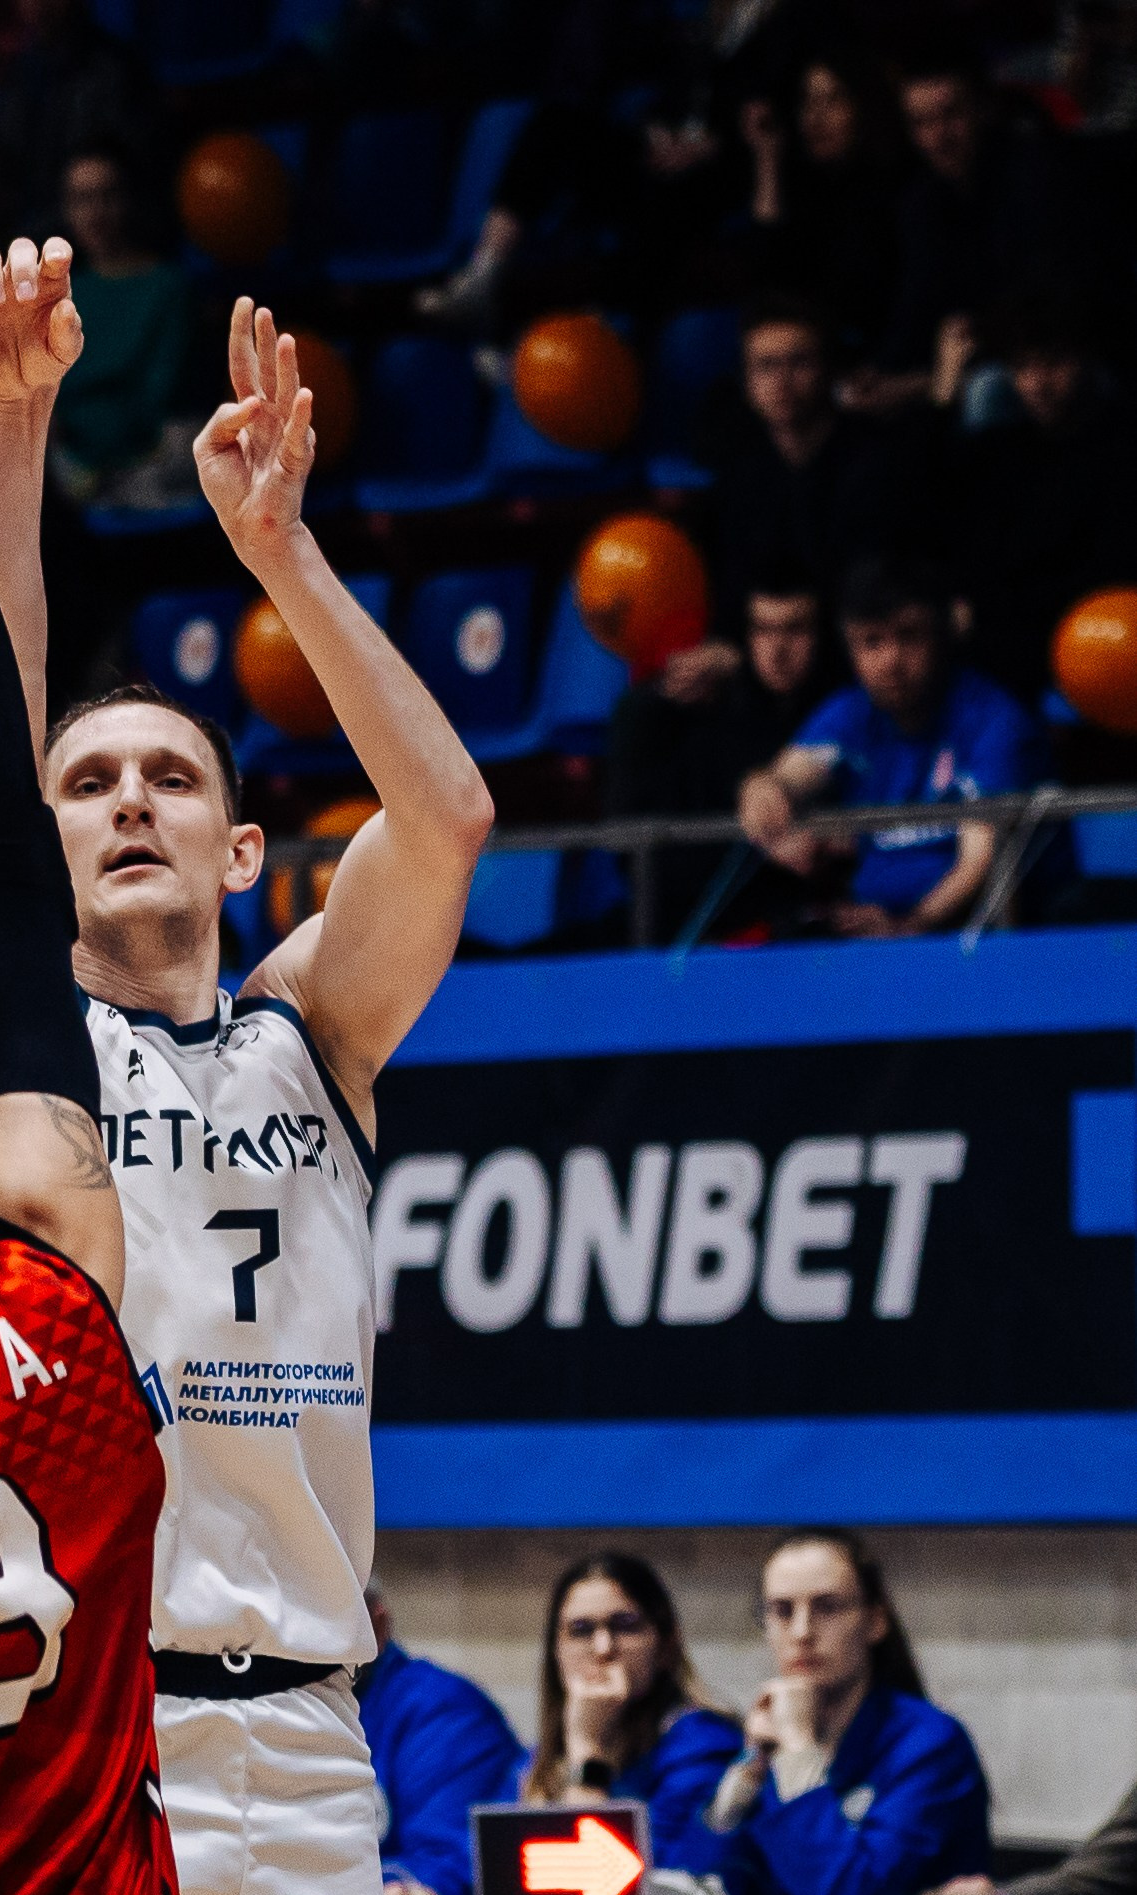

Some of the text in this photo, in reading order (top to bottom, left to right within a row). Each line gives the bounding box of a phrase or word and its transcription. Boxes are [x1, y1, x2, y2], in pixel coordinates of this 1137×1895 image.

[371, 1130, 967, 1335] FONBET
[203, 1208, 281, 1323] 7
[182, 1360, 355, 1382] МАГНИТОГОРСКИЙ
[178, 1383, 365, 1407] МЕТАЛЛУРГИЧЕСКИЙ
[177, 1405, 300, 1428] КОМБИНАТ
